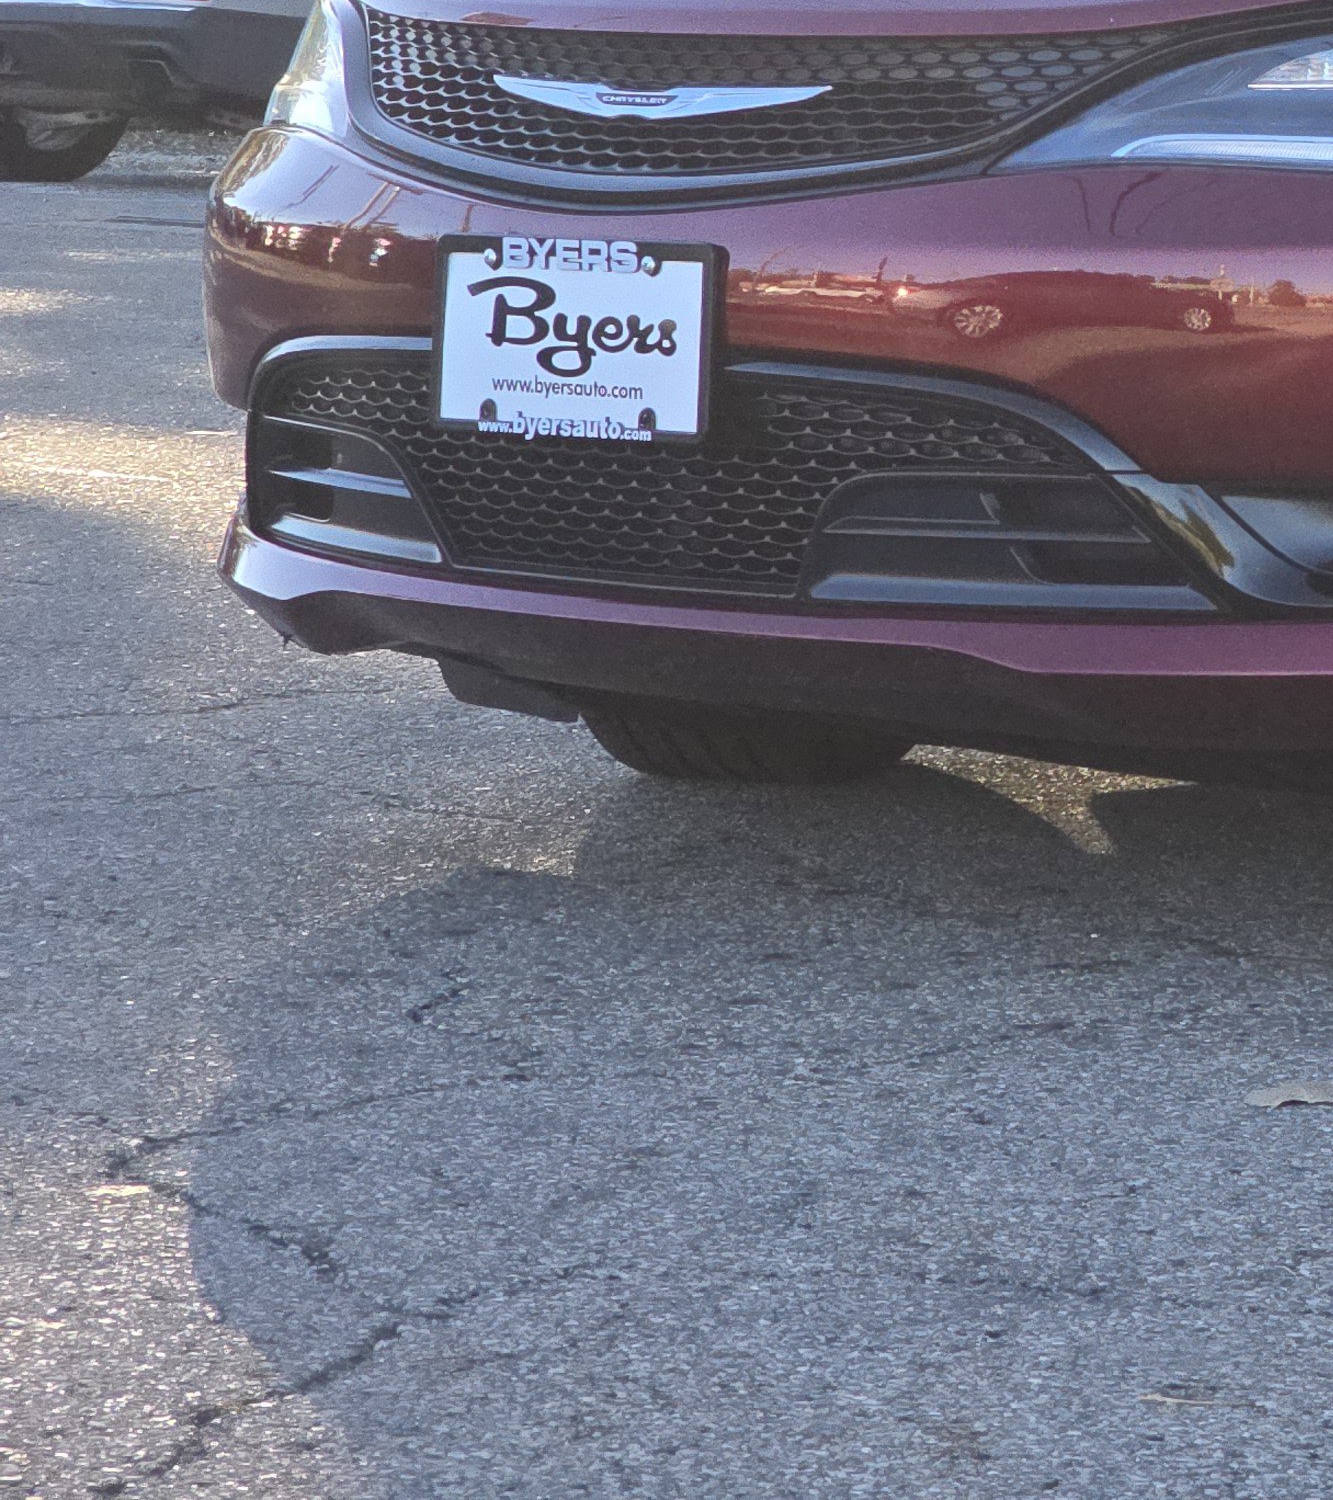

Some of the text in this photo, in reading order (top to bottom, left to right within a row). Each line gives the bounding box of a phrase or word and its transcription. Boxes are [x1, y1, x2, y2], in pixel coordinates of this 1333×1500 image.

[502, 236, 638, 273] BYERS
[466, 275, 677, 378] Byers
[491, 375, 644, 400] www.byersauto.com
[477, 411, 652, 442] www.byersauto.com
